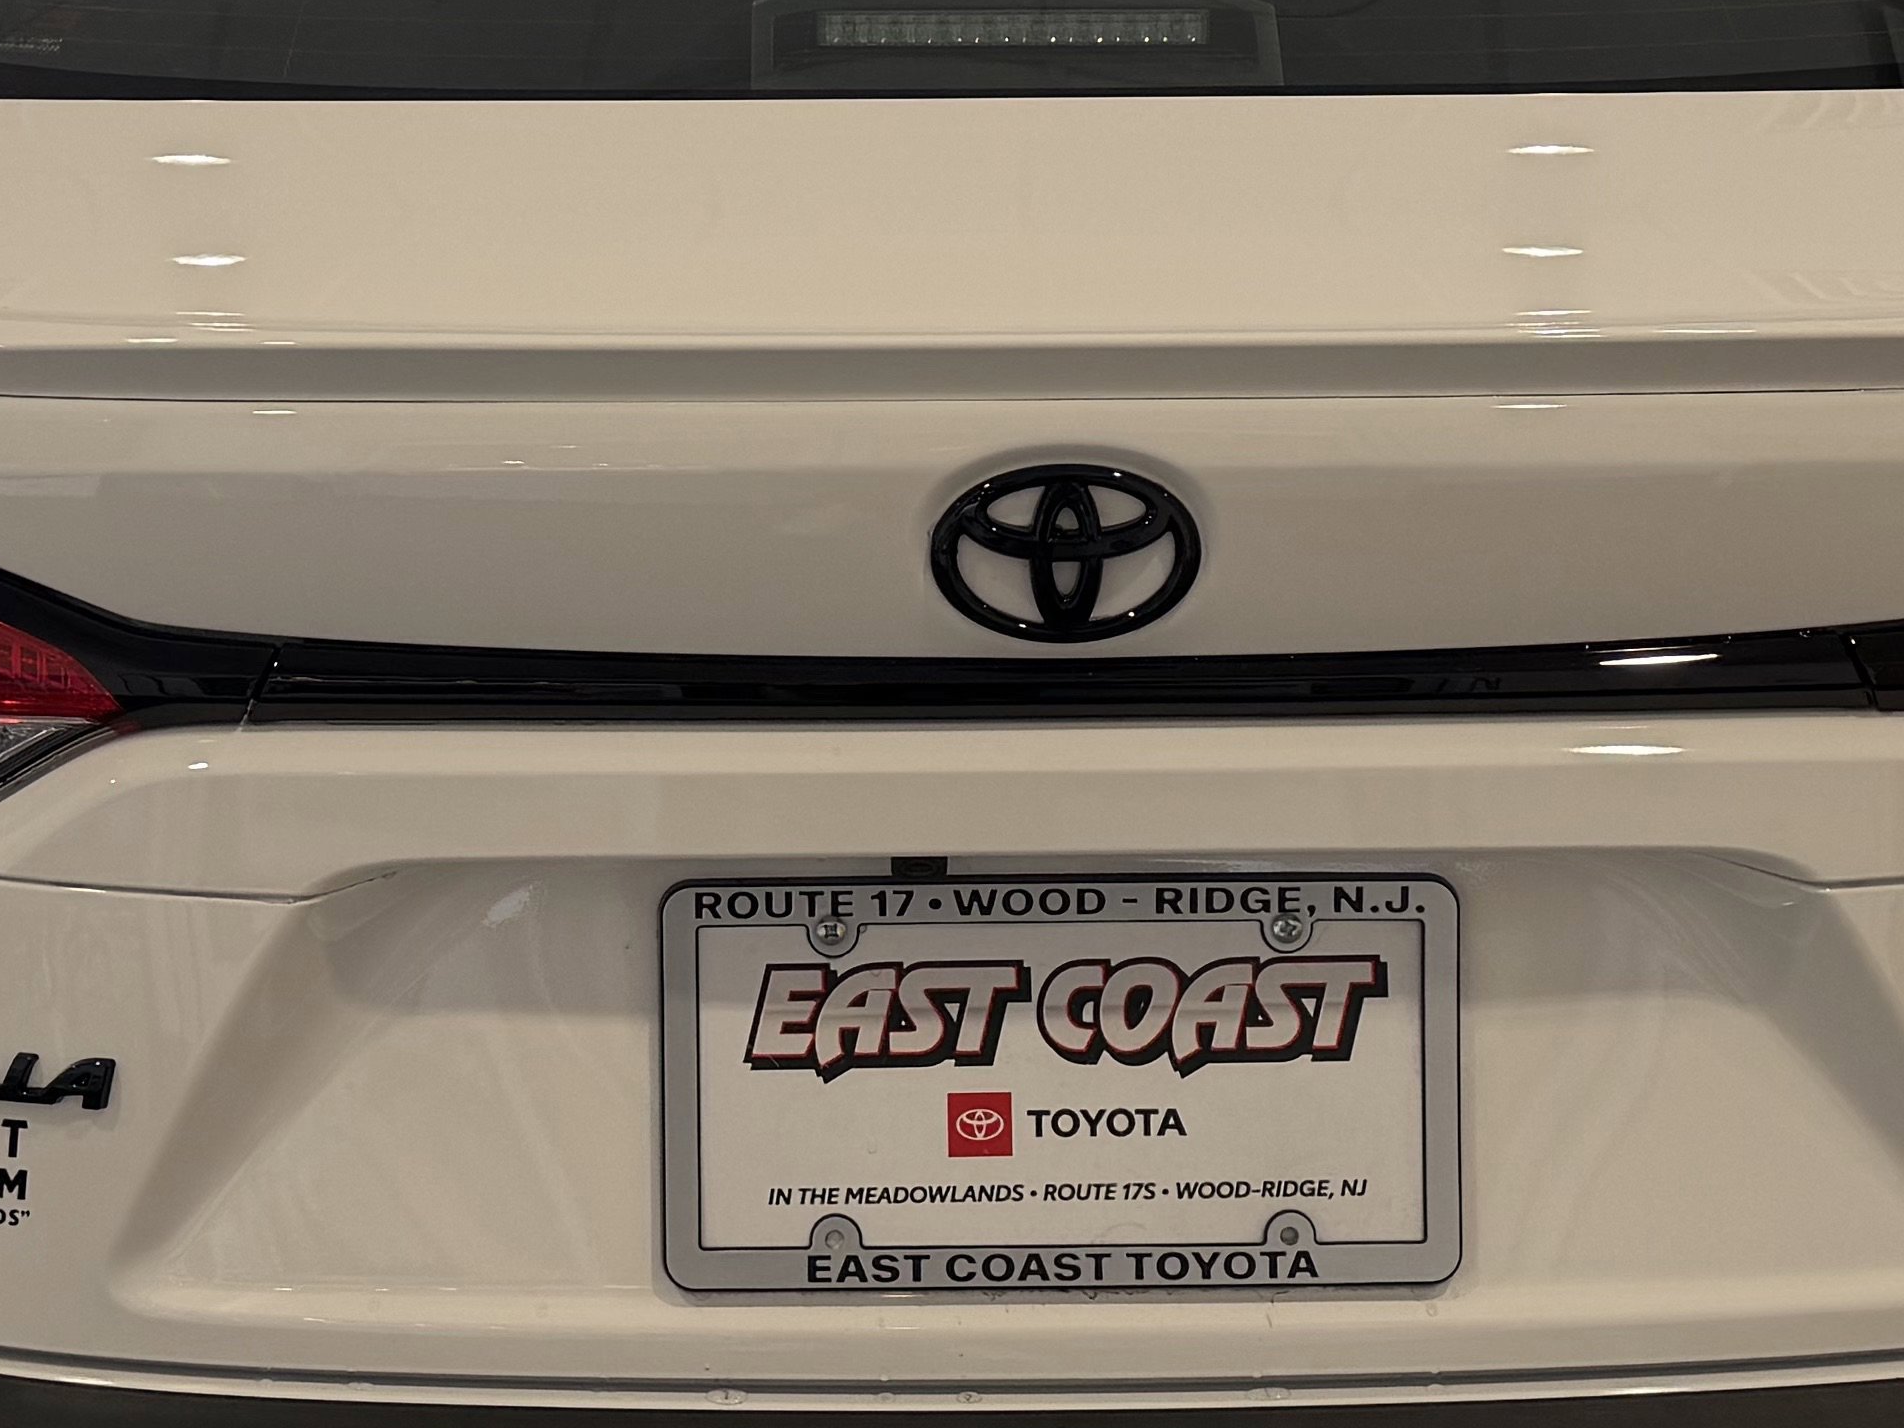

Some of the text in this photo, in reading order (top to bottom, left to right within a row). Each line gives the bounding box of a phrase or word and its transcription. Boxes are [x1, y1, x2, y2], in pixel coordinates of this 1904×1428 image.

[694, 890, 855, 920] ROUTE
[869, 892, 913, 918] 17
[953, 888, 1107, 917] WOOD
[1154, 887, 1317, 917] RIDGE,
[1333, 885, 1426, 914] N.J.
[744, 953, 1390, 1084] EAST COAST
[1026, 1107, 1188, 1138] TOYOTA
[768, 1178, 1368, 1206] IN THE MEADOWLANDS ROUTE 17S WOOD-RIDGE, NJ
[806, 1249, 1320, 1284] EAST COAST TOYOTA
